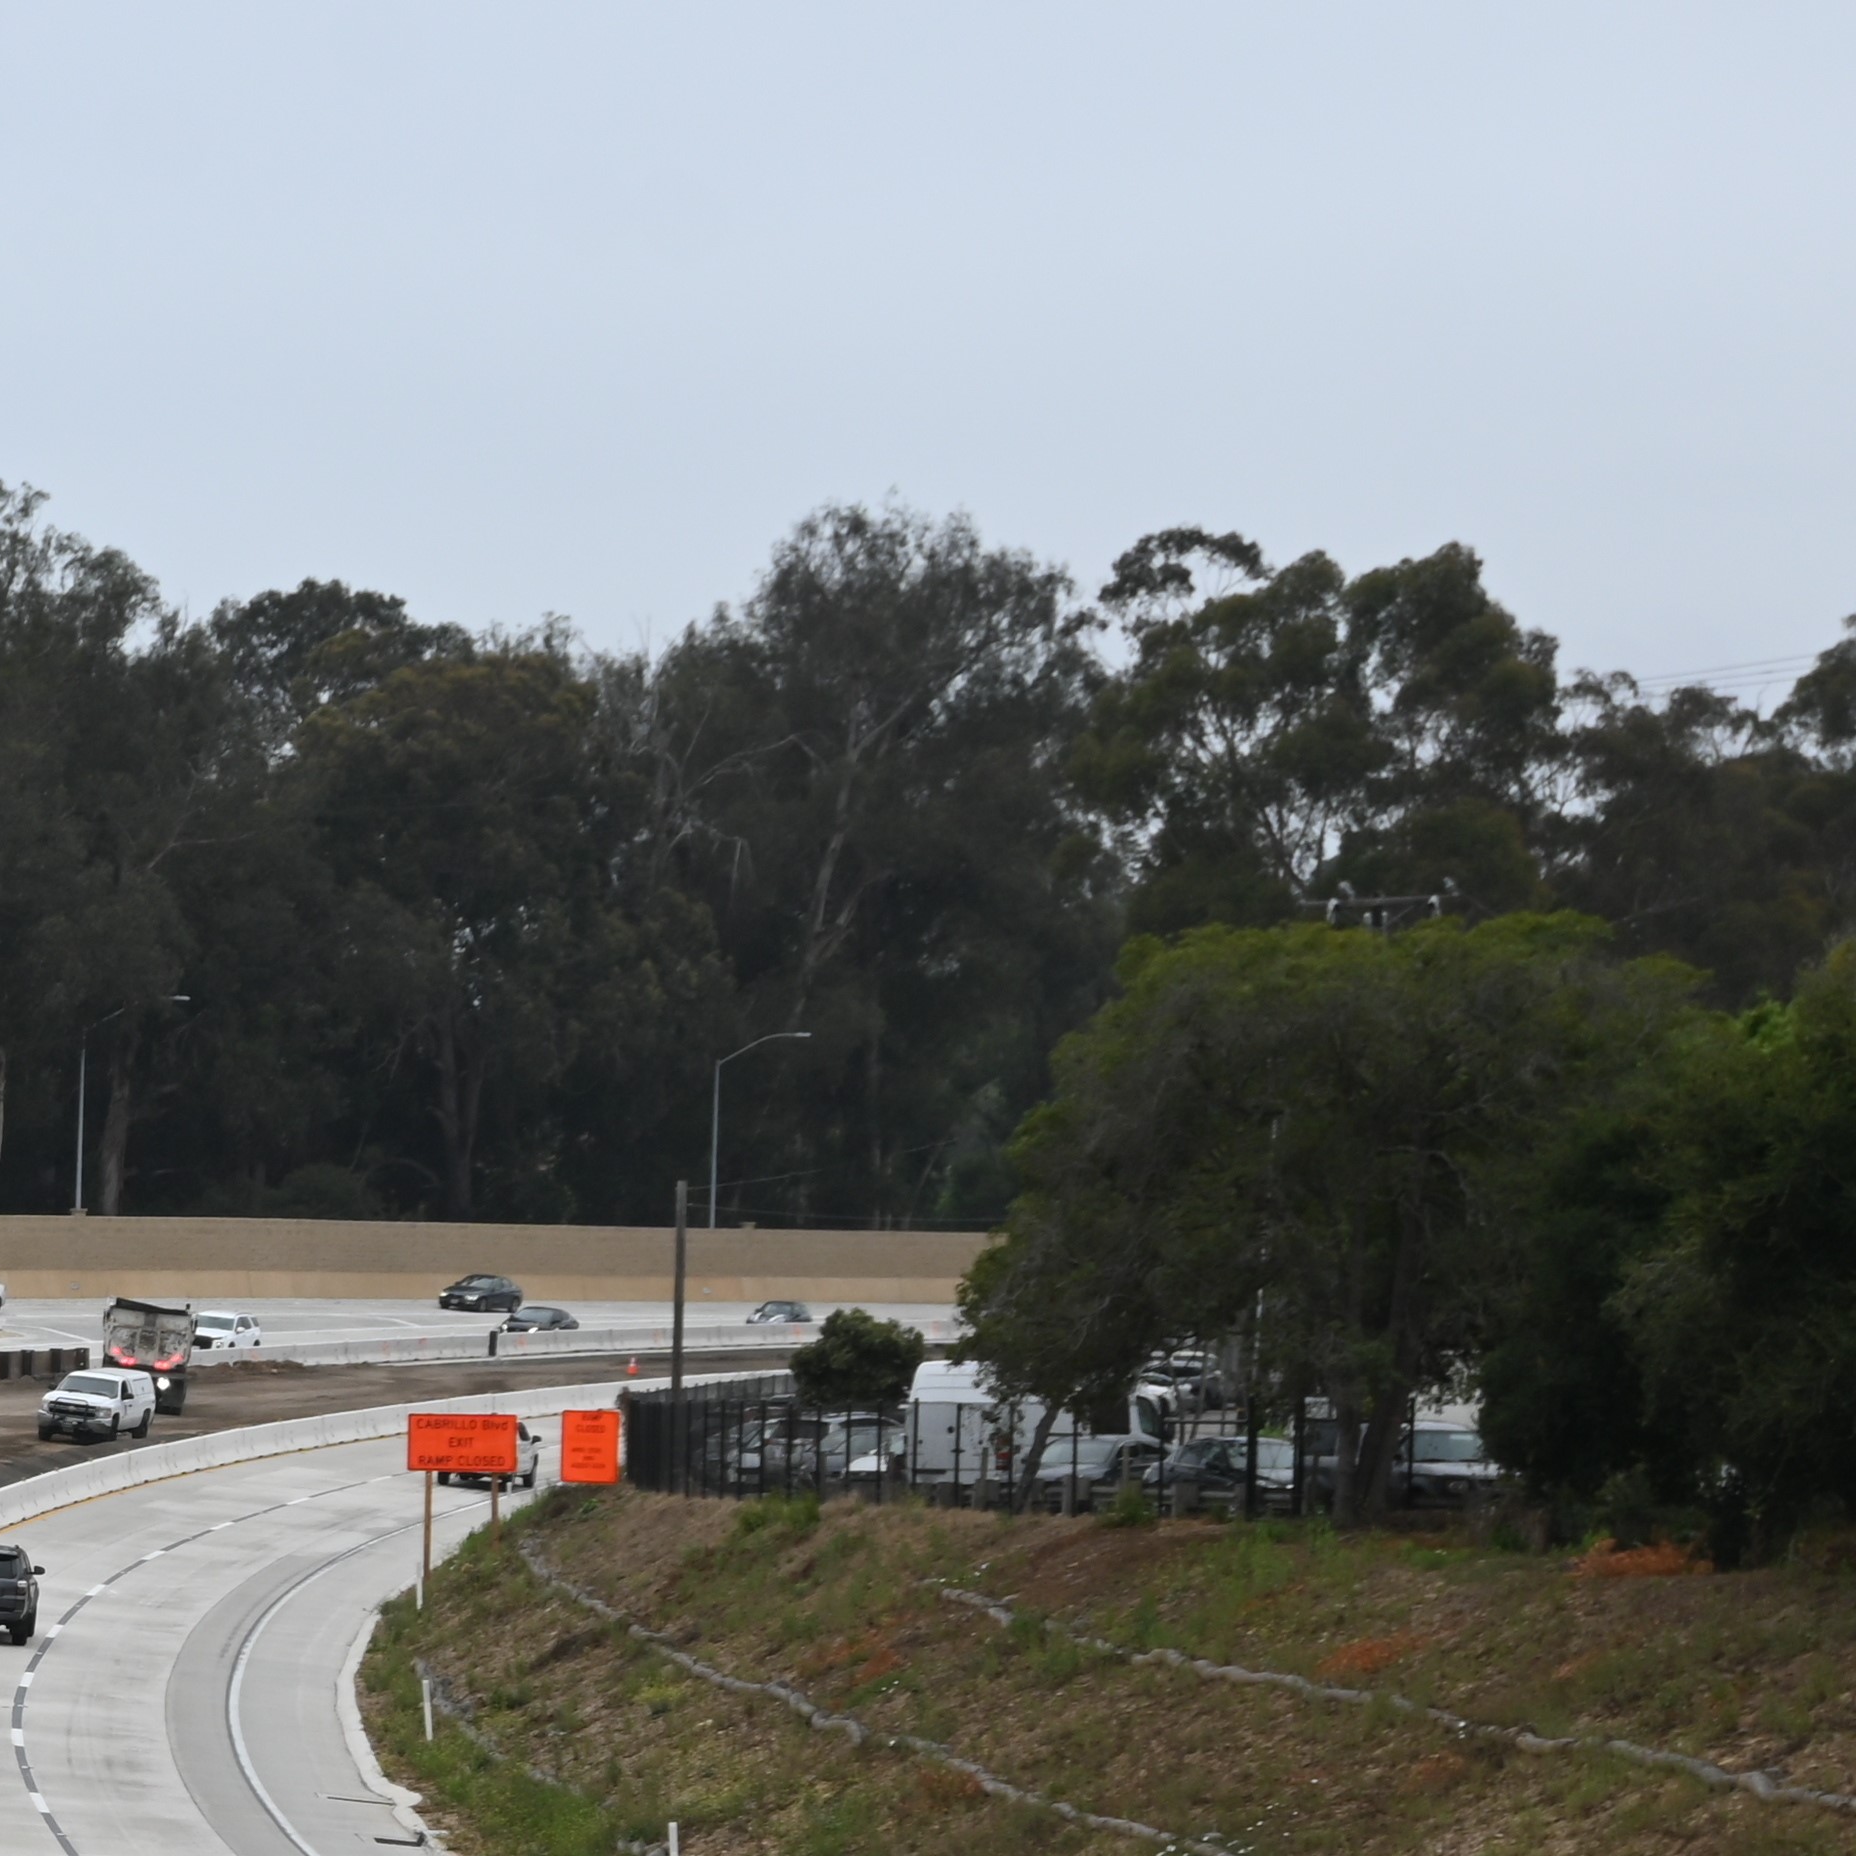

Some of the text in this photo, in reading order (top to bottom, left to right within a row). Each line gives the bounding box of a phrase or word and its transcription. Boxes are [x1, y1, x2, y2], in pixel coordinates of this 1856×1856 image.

[416, 1419, 508, 1431] CABRILLO Blvd
[448, 1437, 474, 1448] EXIT
[418, 1455, 505, 1467] RAMP CLOSED
